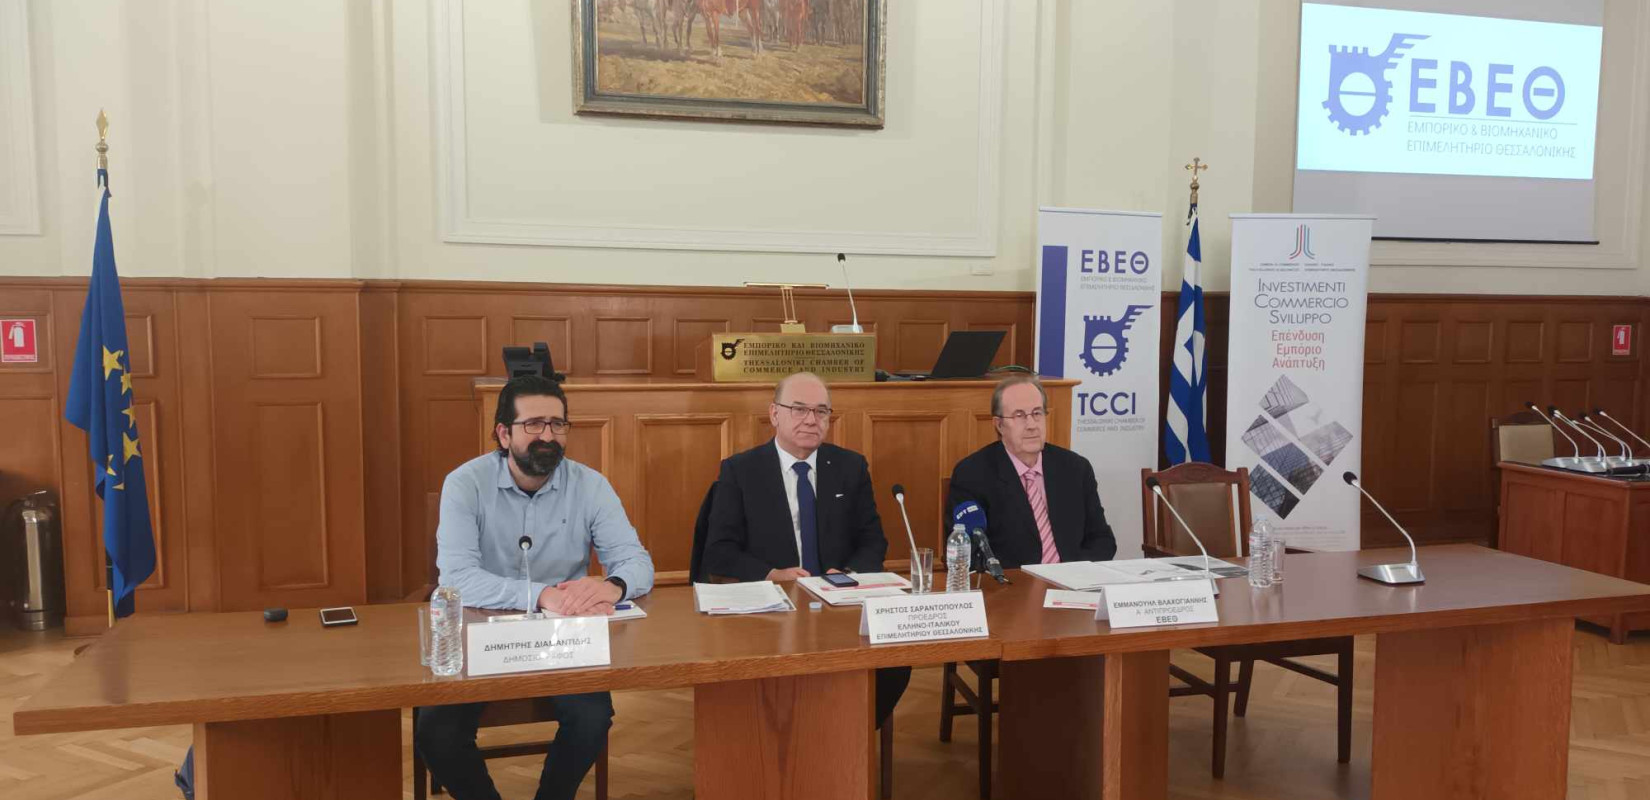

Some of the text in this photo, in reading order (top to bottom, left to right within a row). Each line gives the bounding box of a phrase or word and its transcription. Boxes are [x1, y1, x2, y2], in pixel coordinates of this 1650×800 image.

[1409, 58, 1566, 120] ΕΒΕΘ
[1407, 121, 1558, 140] ΕΜΠΟΡΙΚΟ & ΒΙΟΜΗΧΑΝΙΚΟ
[1407, 139, 1577, 159] ΕΠΙΜΕΛΗΤΗΡΙΟ ΘΕΣΣΑΛΟΝΙΚΗΣ
[1081, 249, 1149, 275] ΕΒΕΘ
[1271, 329, 1325, 344] Επένδυση
[1276, 343, 1322, 357] Εμπόριο
[1272, 357, 1326, 371] Ανάπτυξη
[1077, 392, 1136, 416] TCCI
[875, 602, 974, 614] ΧΡΗΣΤΟΣ ΣΑΡΑΝΤΟΠΟΥΛΟΣ
[1113, 596, 1207, 609] ΕΜΜΑΝΟΥΗΛ ΒΛΑΧΟΓΙΑΝΝΗΣ
[908, 612, 947, 621] ΠΡΟΕΔΡΟΣ
[1156, 615, 1178, 623] ΕΒΕΘ
[897, 620, 960, 630] ΕΛΛΗΝΟ-ΙΤΑΛΙΚΟΥ
[876, 626, 984, 640] ΕΠΙΜΕΛΗΤΗΡΙΟΥ ΘΕΣΣΑΛΟΝΙΚΗΣ
[484, 641, 532, 652] ΔΗΜΗΤΡΗΣ
[503, 651, 574, 663] ΔΗΜΟΣΙΟΑΦΟΣ
